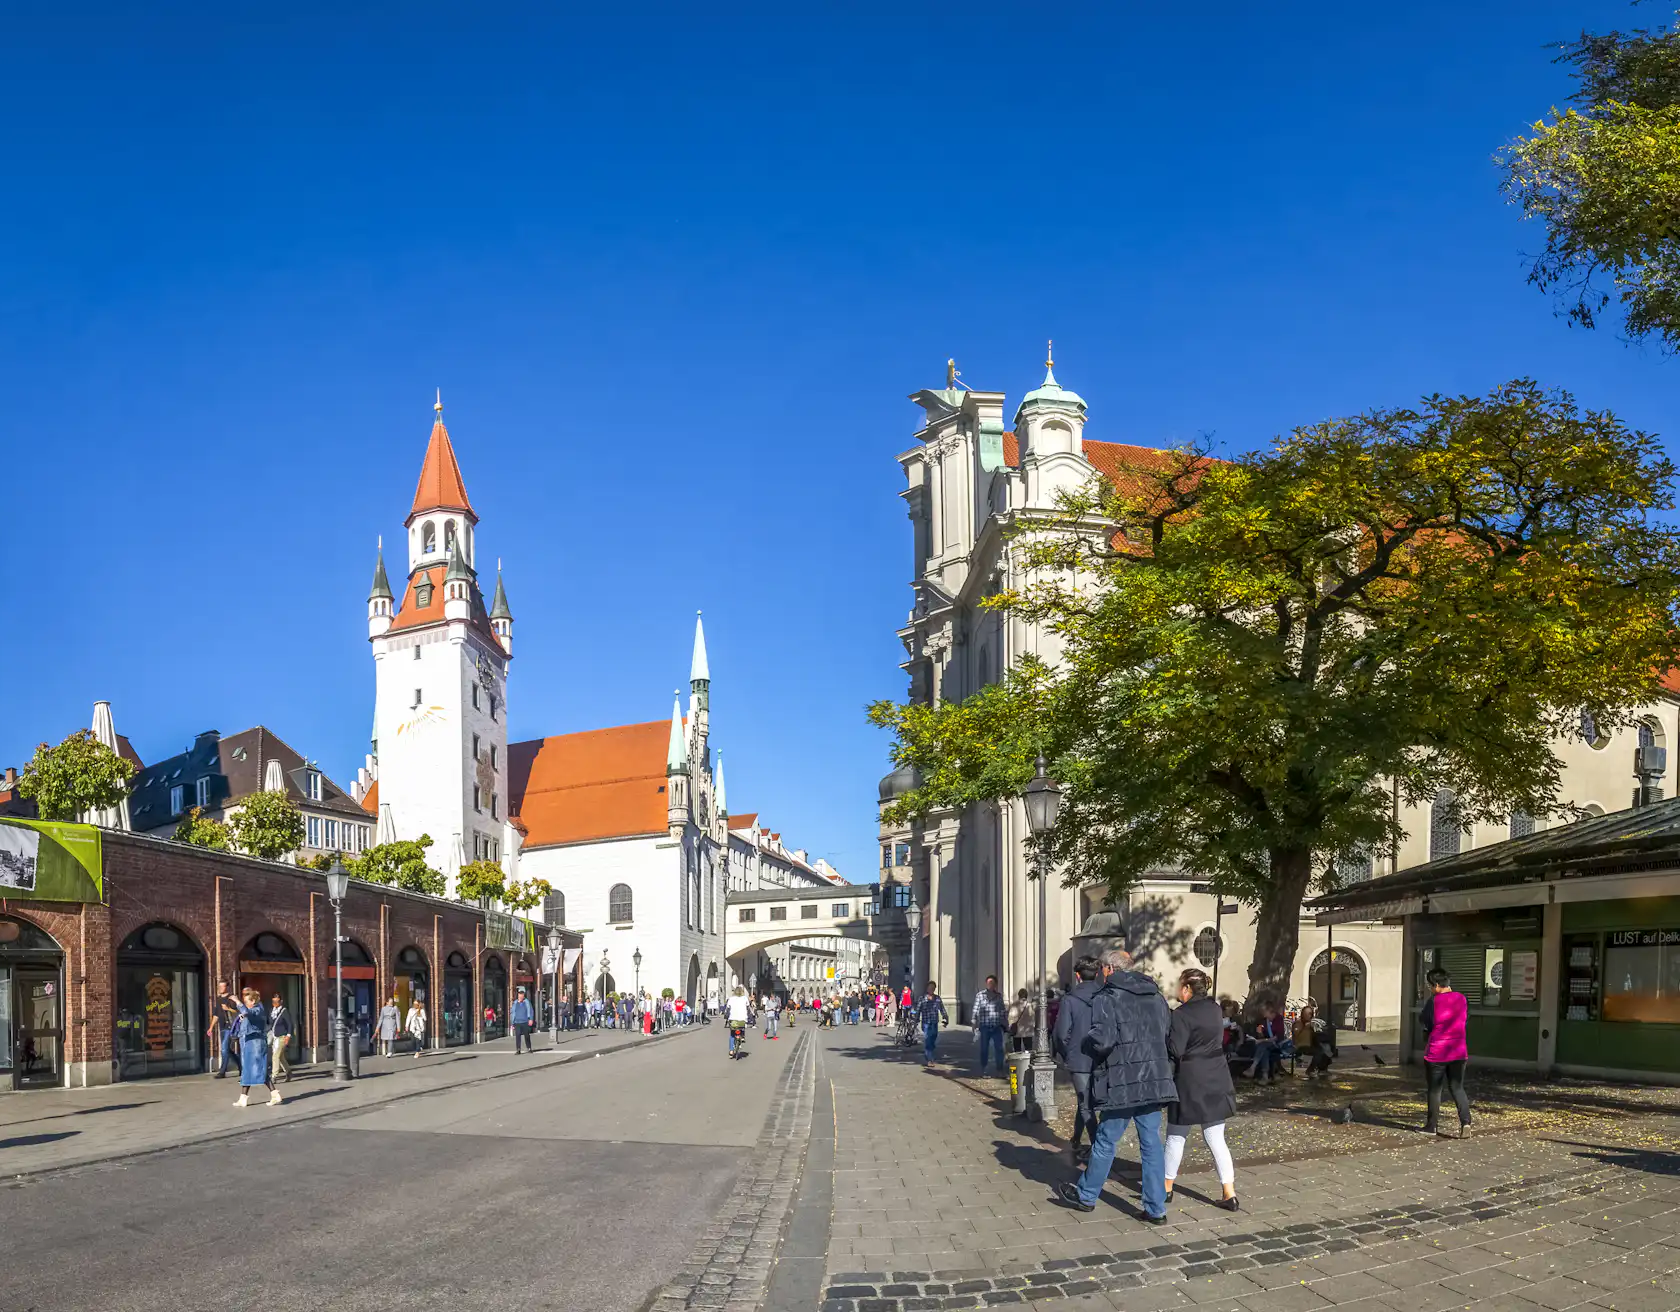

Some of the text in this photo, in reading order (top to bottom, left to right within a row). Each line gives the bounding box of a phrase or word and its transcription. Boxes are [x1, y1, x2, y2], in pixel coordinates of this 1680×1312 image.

[1613, 931, 1680, 945] LUST auf Delik
